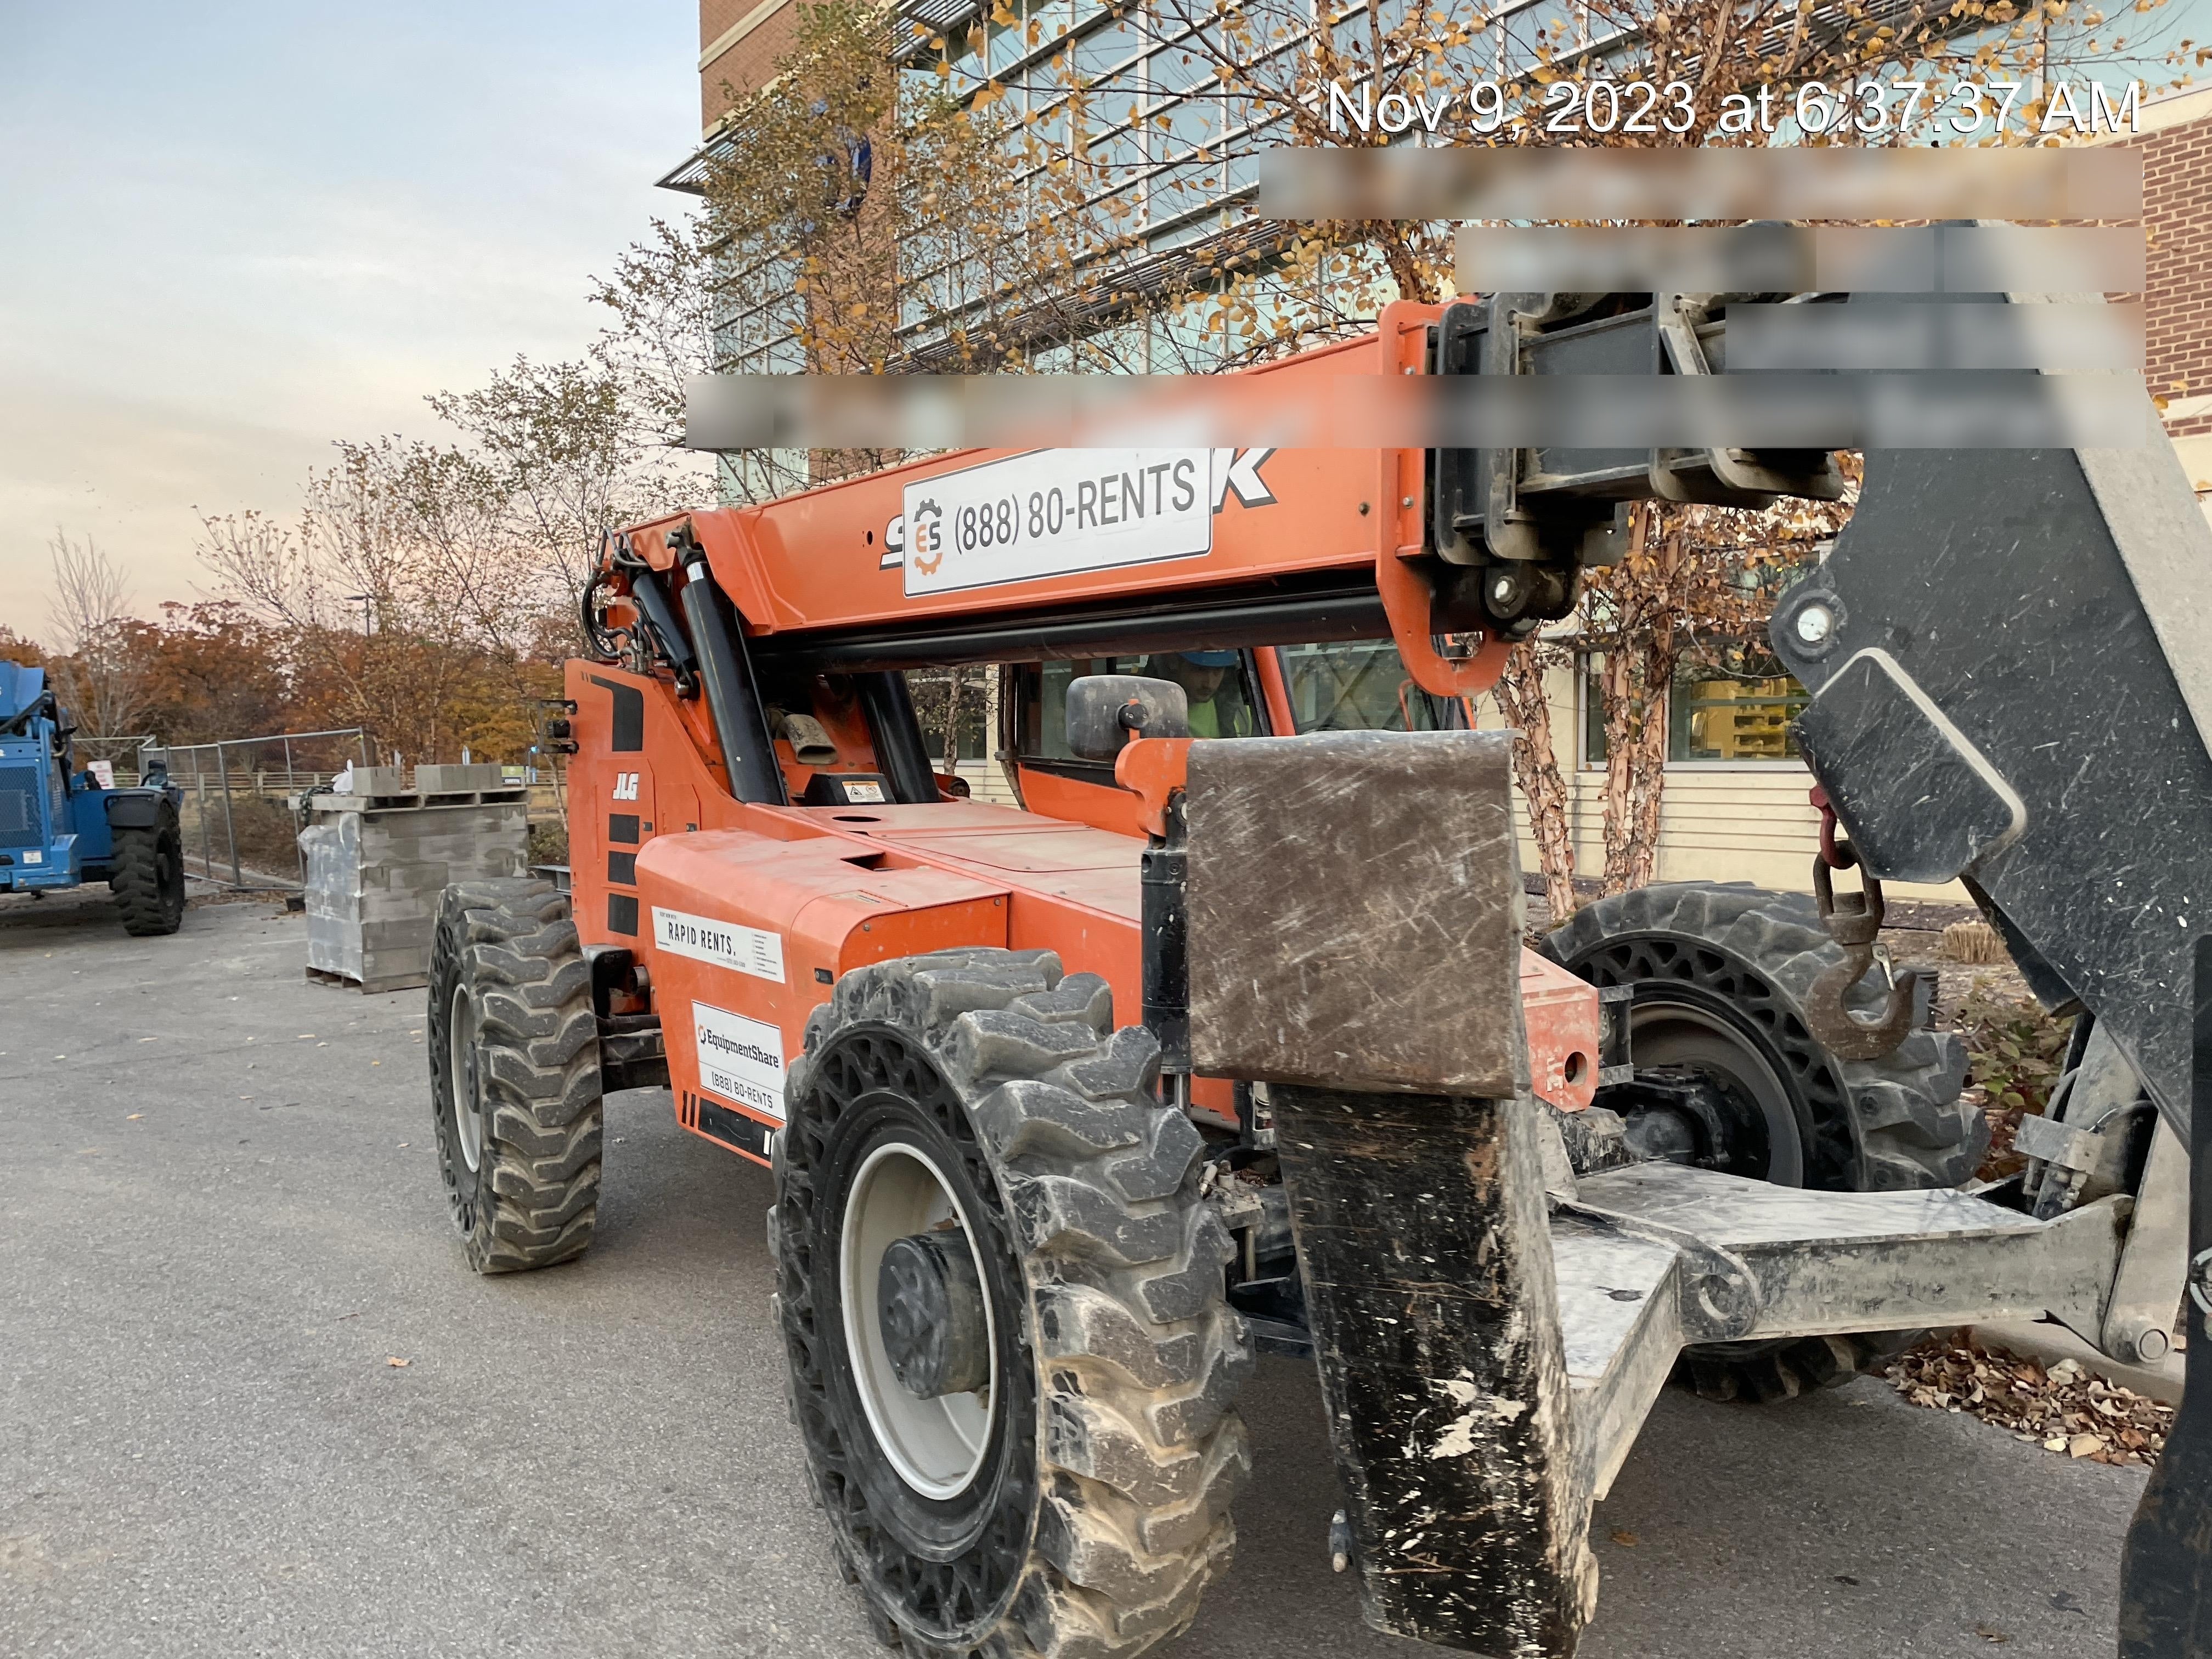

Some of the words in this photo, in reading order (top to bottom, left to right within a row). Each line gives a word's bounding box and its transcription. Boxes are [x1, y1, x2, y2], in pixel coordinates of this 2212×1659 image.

[955, 493, 1019, 555] (888)
[1028, 458, 1195, 539] 80-RENTS
[612, 772, 639, 801] JLG
[668, 922, 696, 945] RAPID
[701, 929, 736, 956] RENTS.
[707, 1029, 780, 1068] EquipmentShare
[712, 1071, 732, 1093] (888)
[735, 1081, 773, 1109] 80-RENTS
